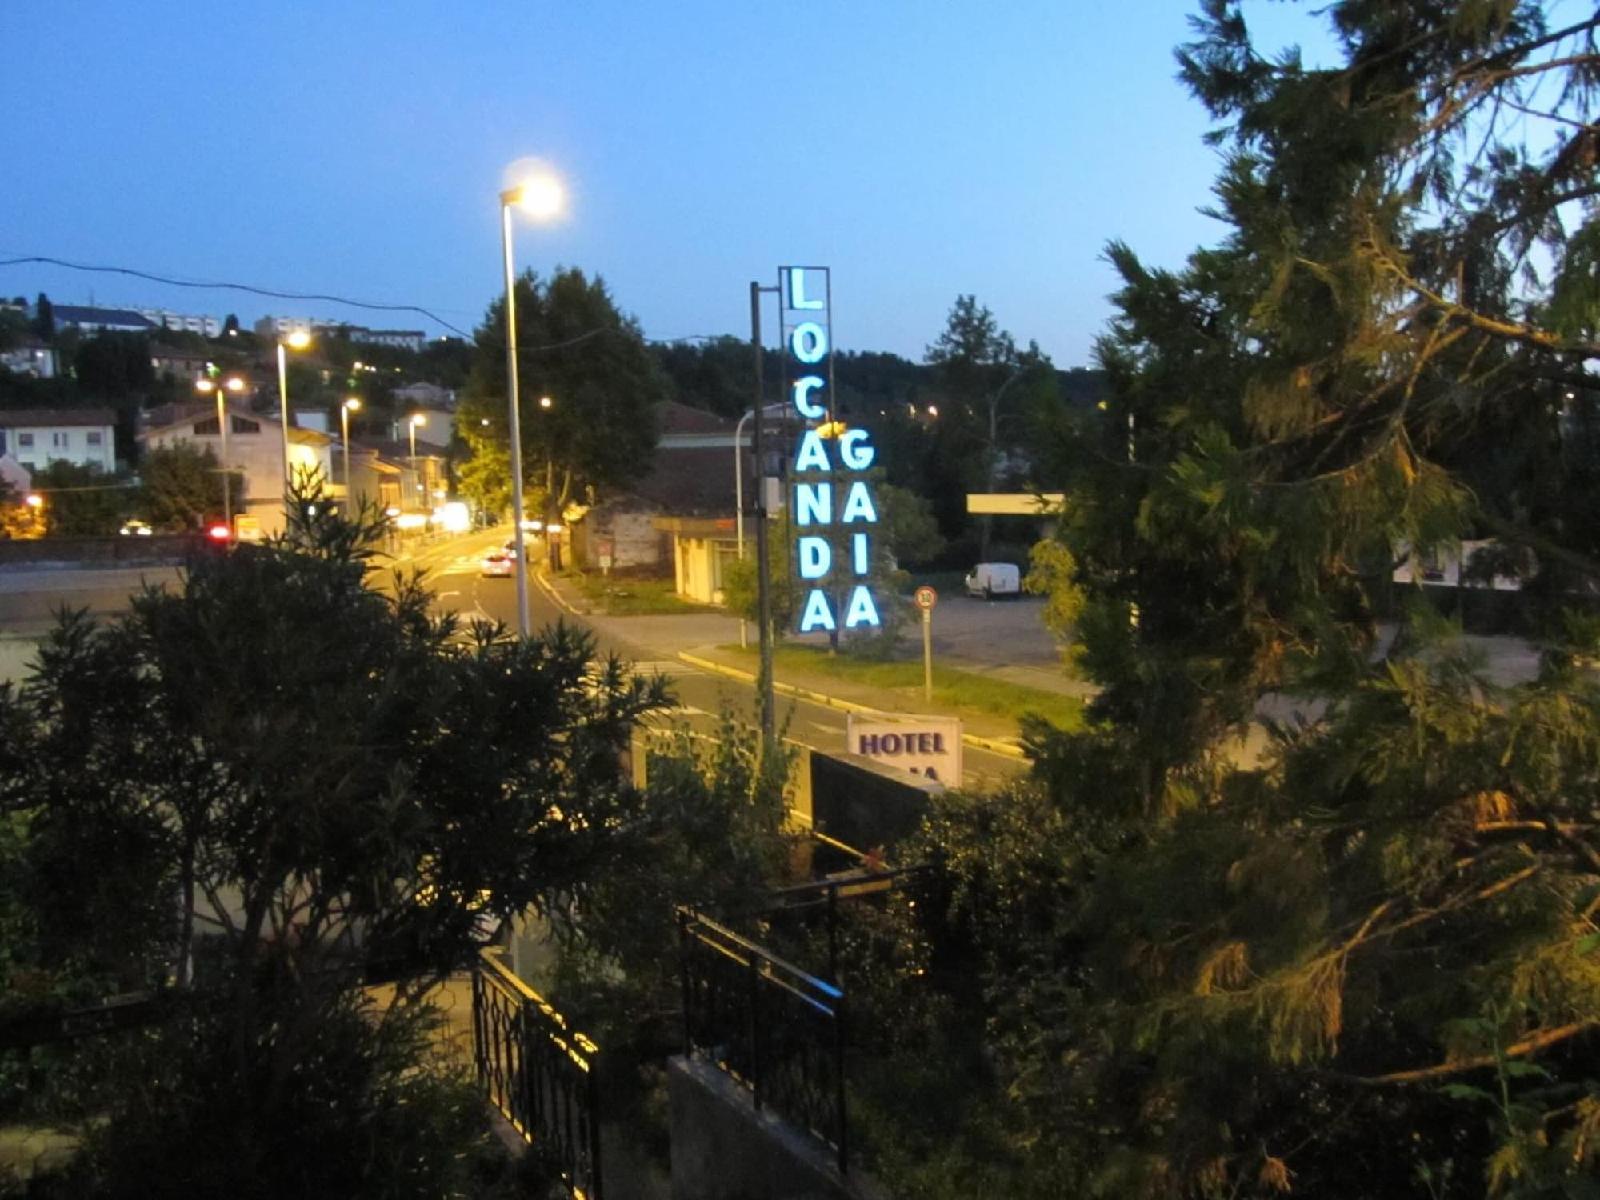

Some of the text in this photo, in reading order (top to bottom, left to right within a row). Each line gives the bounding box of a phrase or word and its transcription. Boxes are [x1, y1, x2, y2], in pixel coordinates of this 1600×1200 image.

[790, 267, 835, 632] LOCANDA
[840, 428, 880, 628] GAIA
[859, 732, 946, 755] HOTEL
